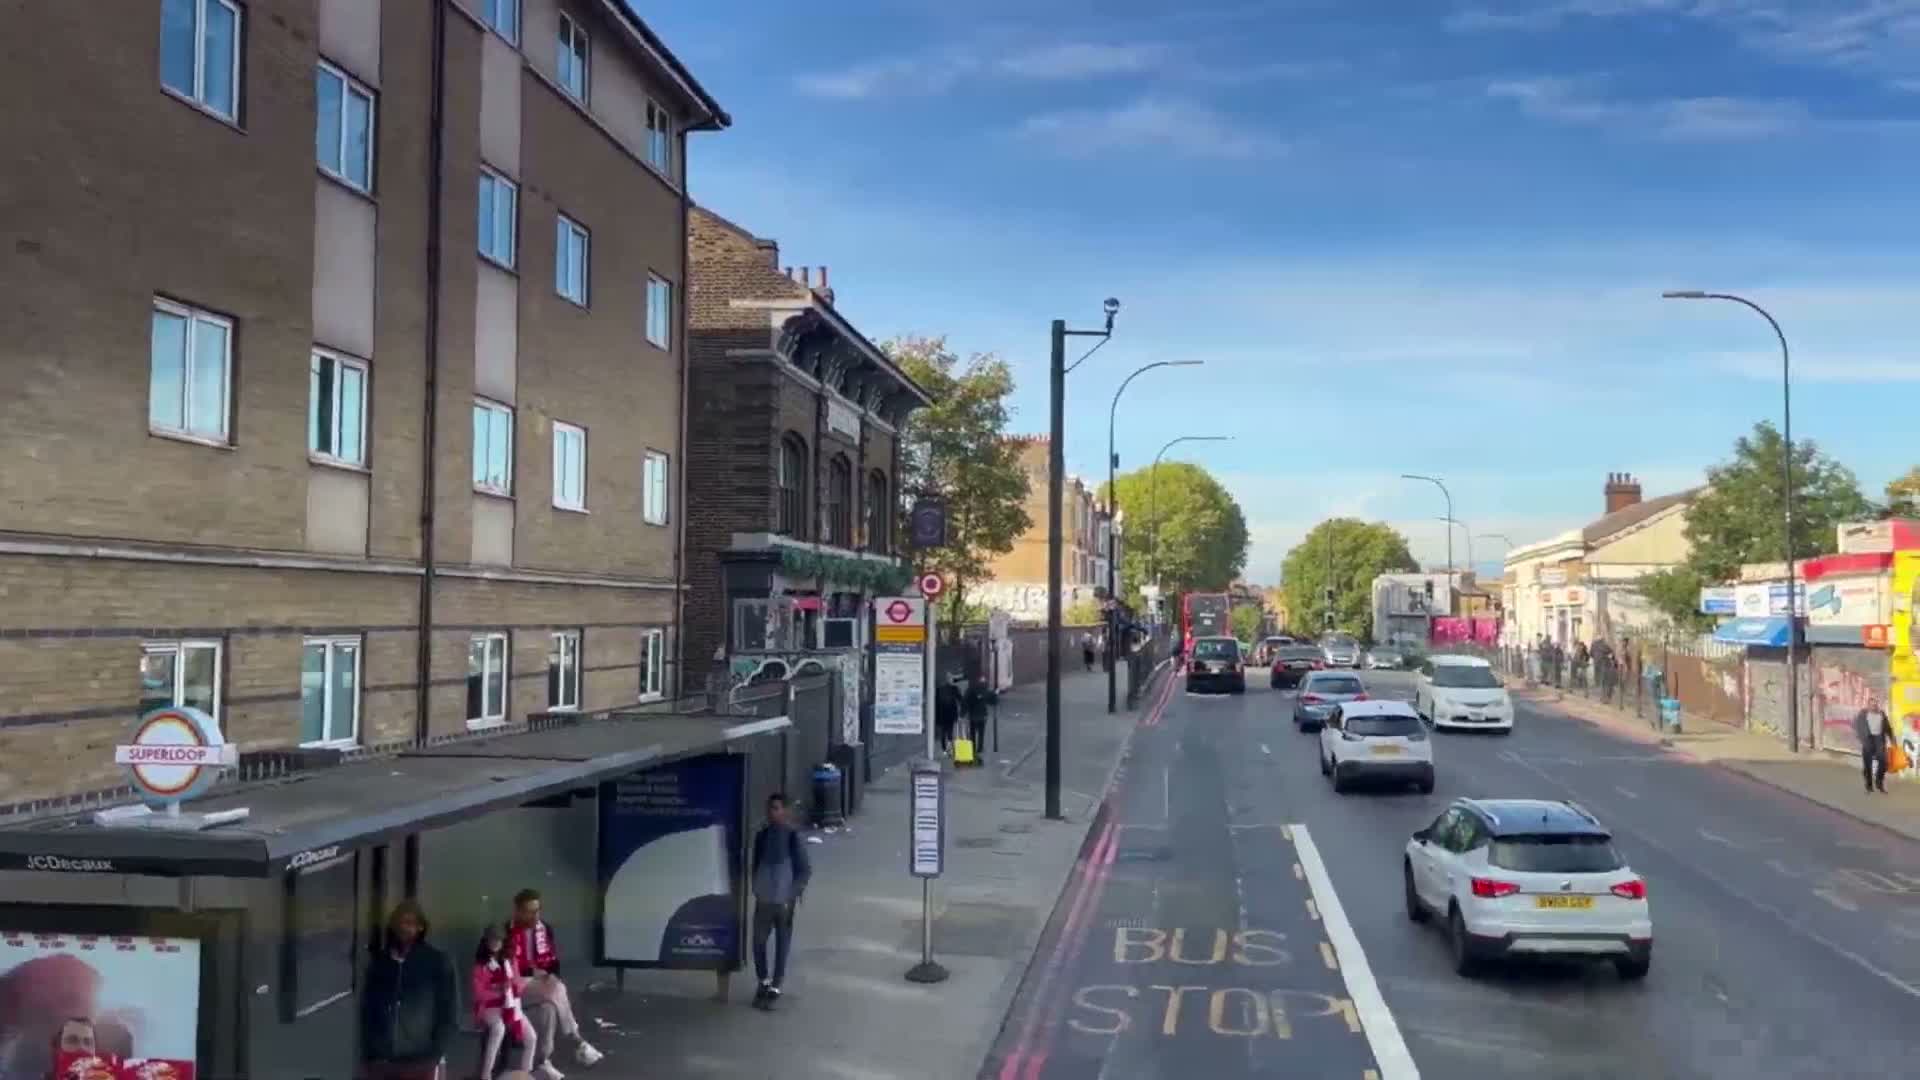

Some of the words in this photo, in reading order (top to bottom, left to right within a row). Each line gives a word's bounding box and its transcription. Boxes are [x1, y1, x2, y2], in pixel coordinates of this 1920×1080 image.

[128, 747, 207, 761] SUPERLOOP
[27, 855, 114, 872] JCDecaux
[1113, 927, 1293, 966] BUS
[1067, 985, 1345, 1039] STOP
